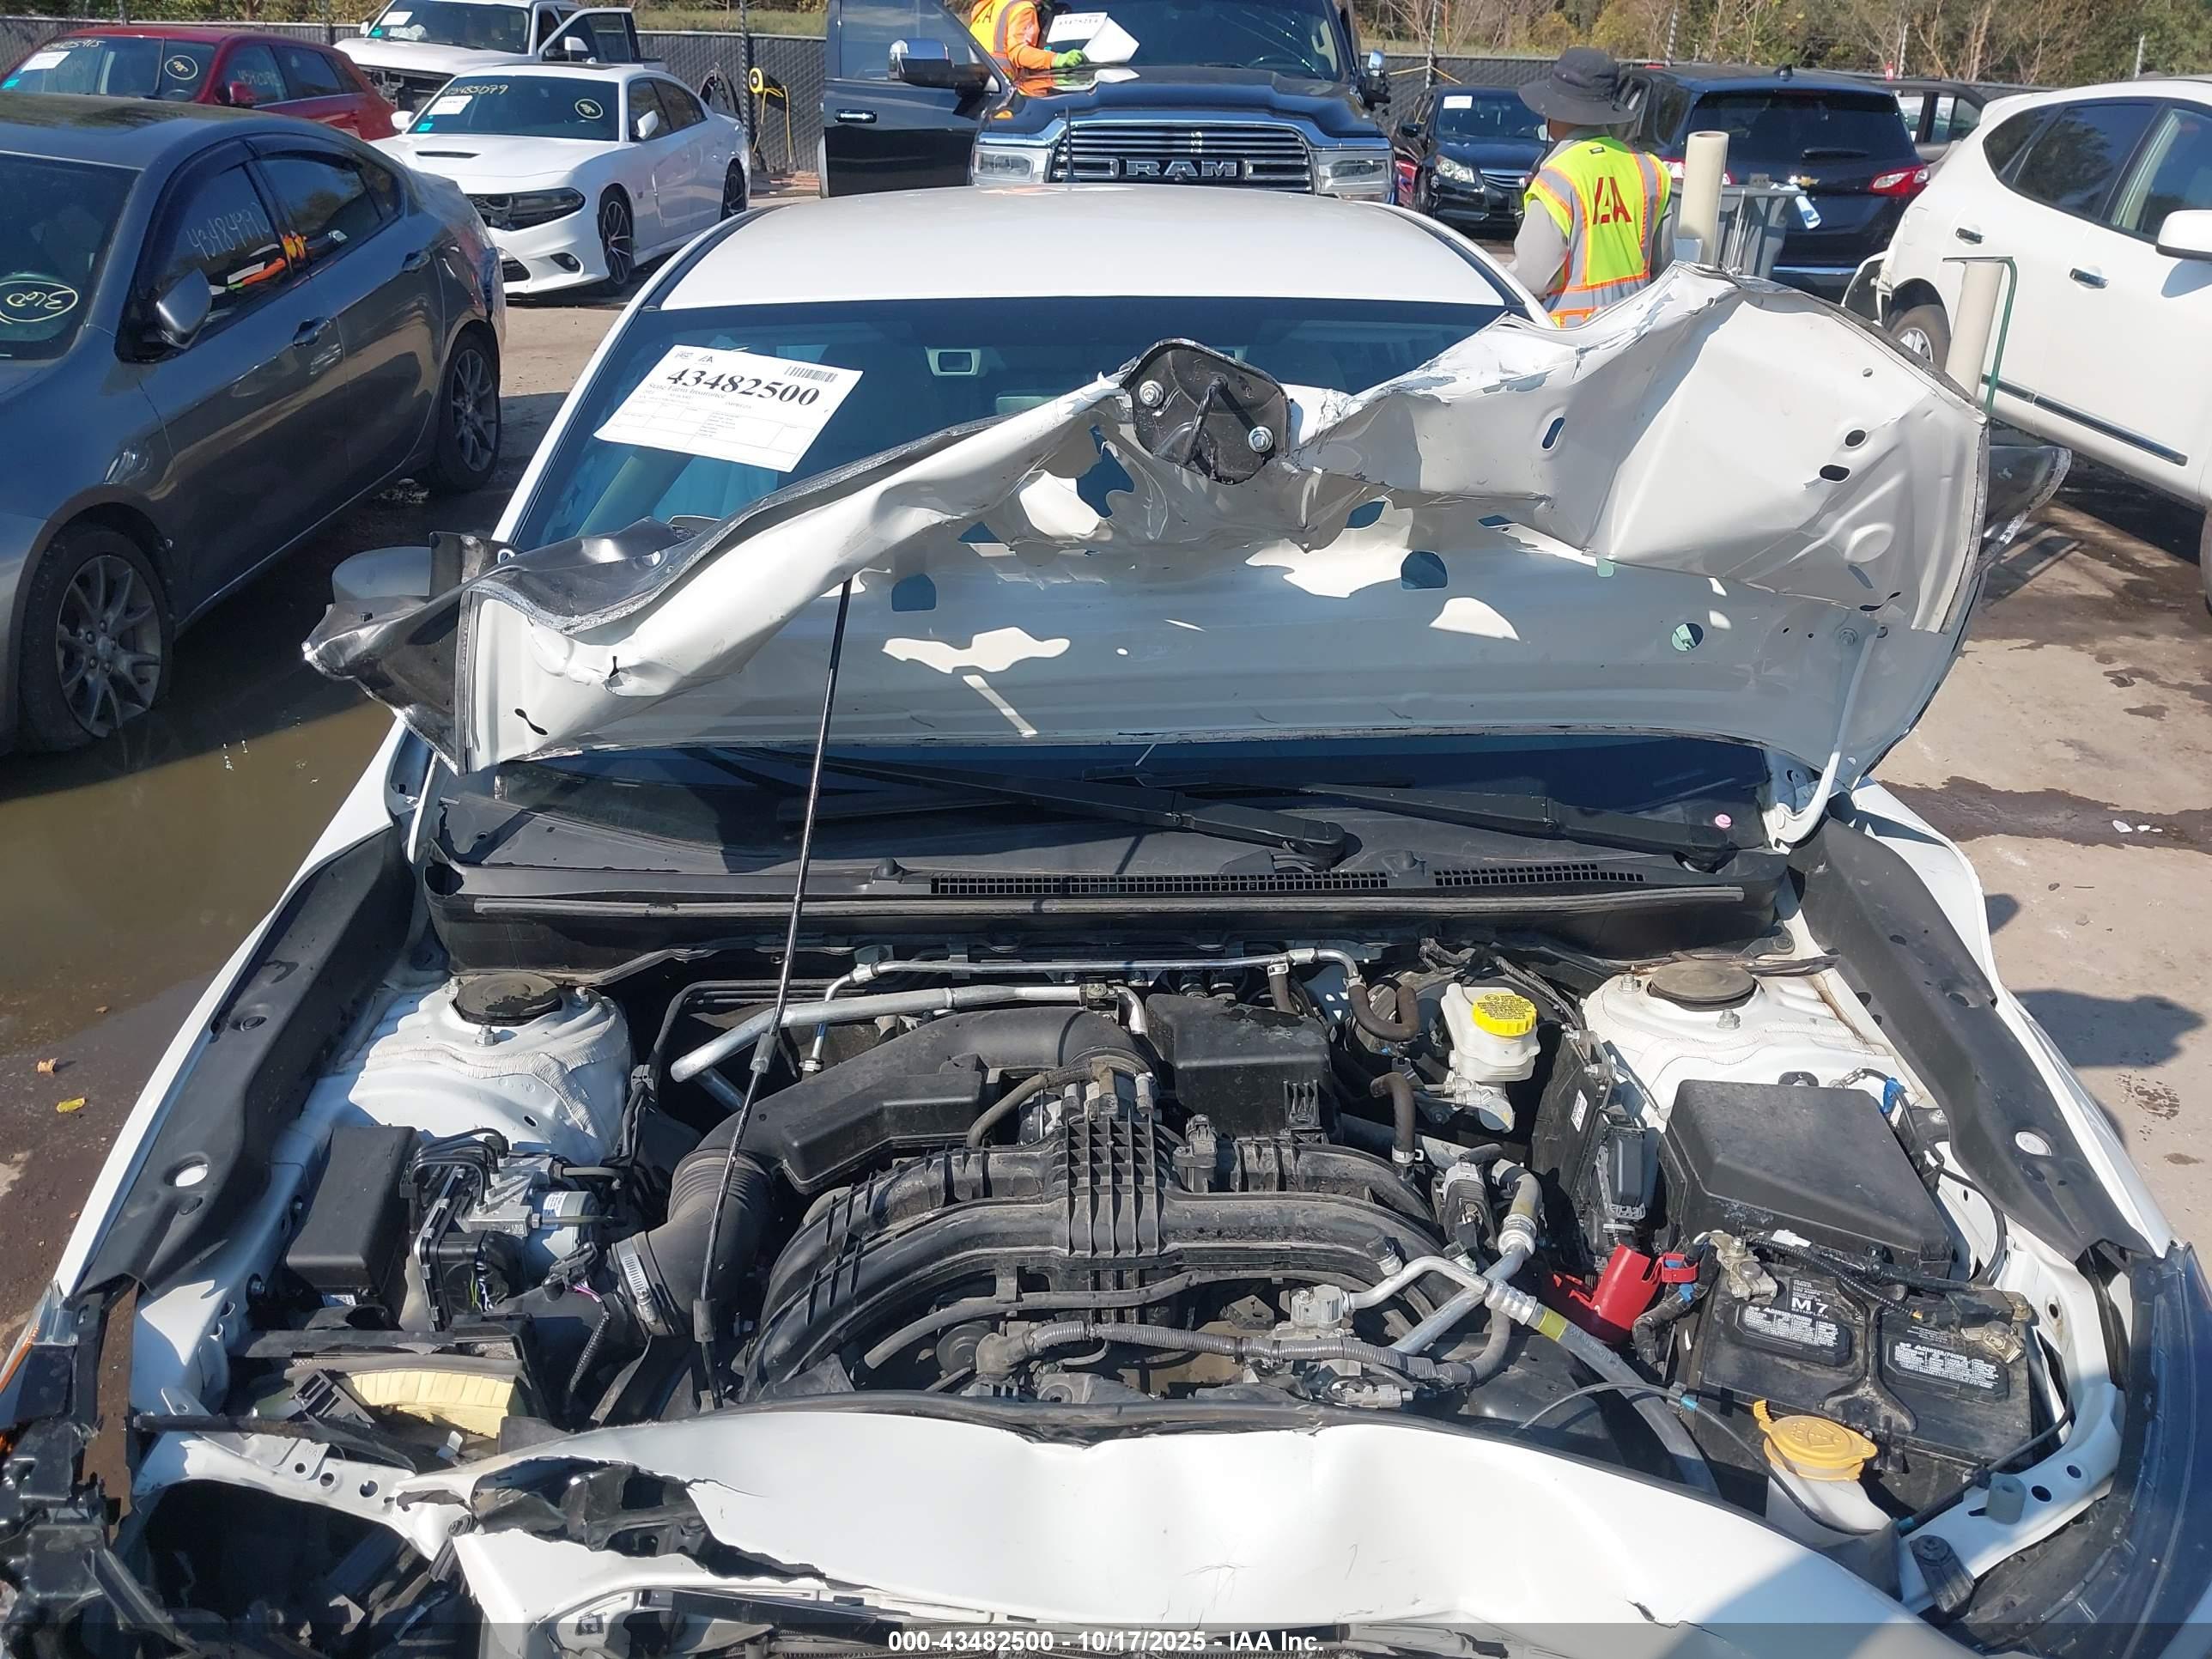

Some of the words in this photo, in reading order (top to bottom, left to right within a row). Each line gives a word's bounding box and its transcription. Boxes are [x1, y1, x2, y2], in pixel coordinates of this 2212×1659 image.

[1126, 159, 1237, 177] RAM
[665, 368, 820, 406] 43482500
[1791, 1297, 1812, 1312] M
[1815, 1302, 1829, 1315] 7
